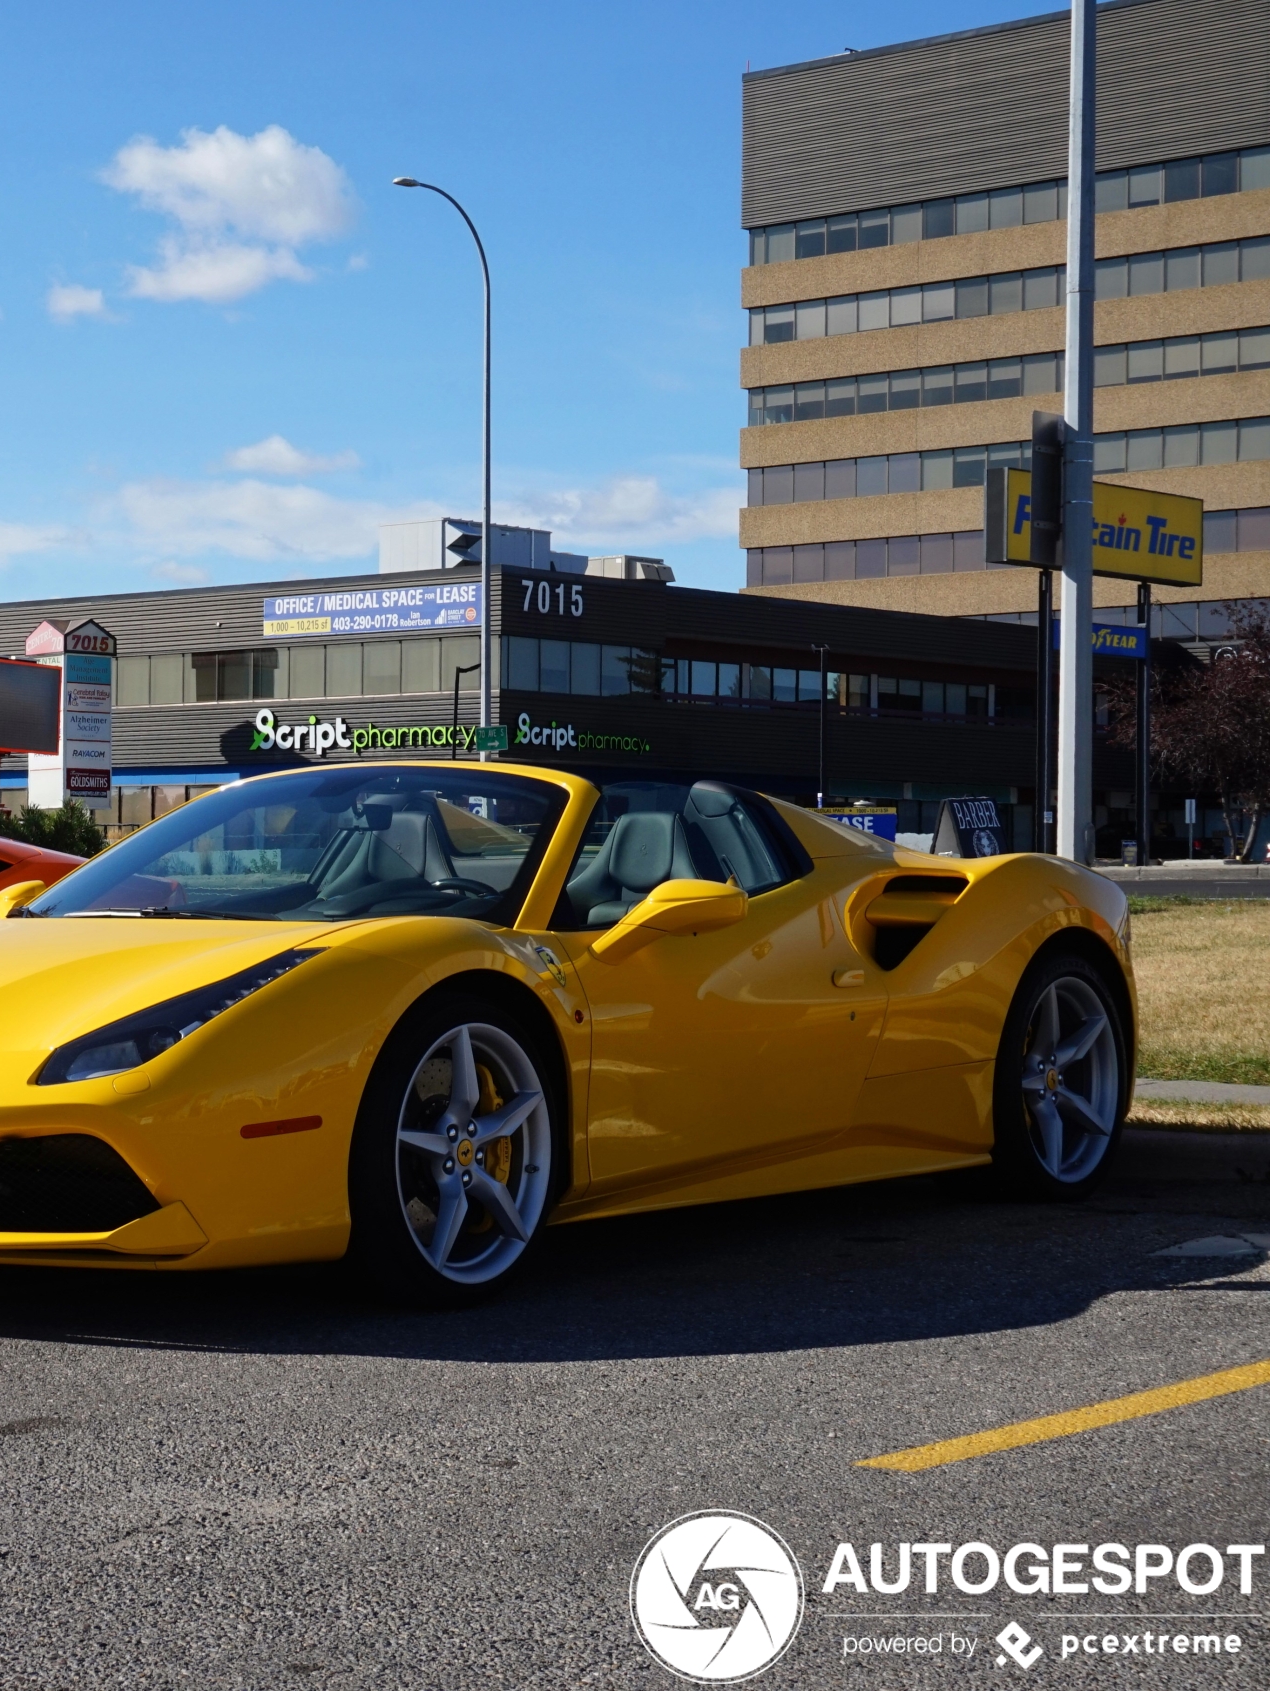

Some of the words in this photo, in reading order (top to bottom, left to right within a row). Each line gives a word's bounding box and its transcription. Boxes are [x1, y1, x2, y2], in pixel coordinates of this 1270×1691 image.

[1146, 515, 1195, 560] Tire
[275, 597, 315, 615] OFFICE
[316, 596, 322, 613] /
[324, 592, 379, 611] MEDICAL
[382, 589, 423, 608] SPACE
[424, 592, 435, 600] FOR
[436, 585, 476, 604] LEASE
[521, 579, 584, 617] 7015
[270, 622, 289, 634] 1,000
[297, 619, 319, 632] 10,215
[321, 618, 328, 630] sf
[332, 613, 398, 631] 403-290-0178
[400, 618, 431, 628] Robertson
[410, 611, 421, 620] Ian
[27, 628, 53, 652] CENTRE
[52, 637, 63, 651] 70
[71, 634, 109, 652] 7015
[70, 715, 107, 724] Alzheimer
[77, 723, 101, 734] Society
[249, 708, 352, 755] Script
[478, 730, 486, 738] 70
[488, 729, 497, 738] AVE
[500, 728, 504, 737] S
[514, 712, 577, 751] Script
[72, 749, 106, 758] RAYACOM
[70, 776, 108, 788] GOLDSMITHS
[953, 800, 1001, 829] BARBER
